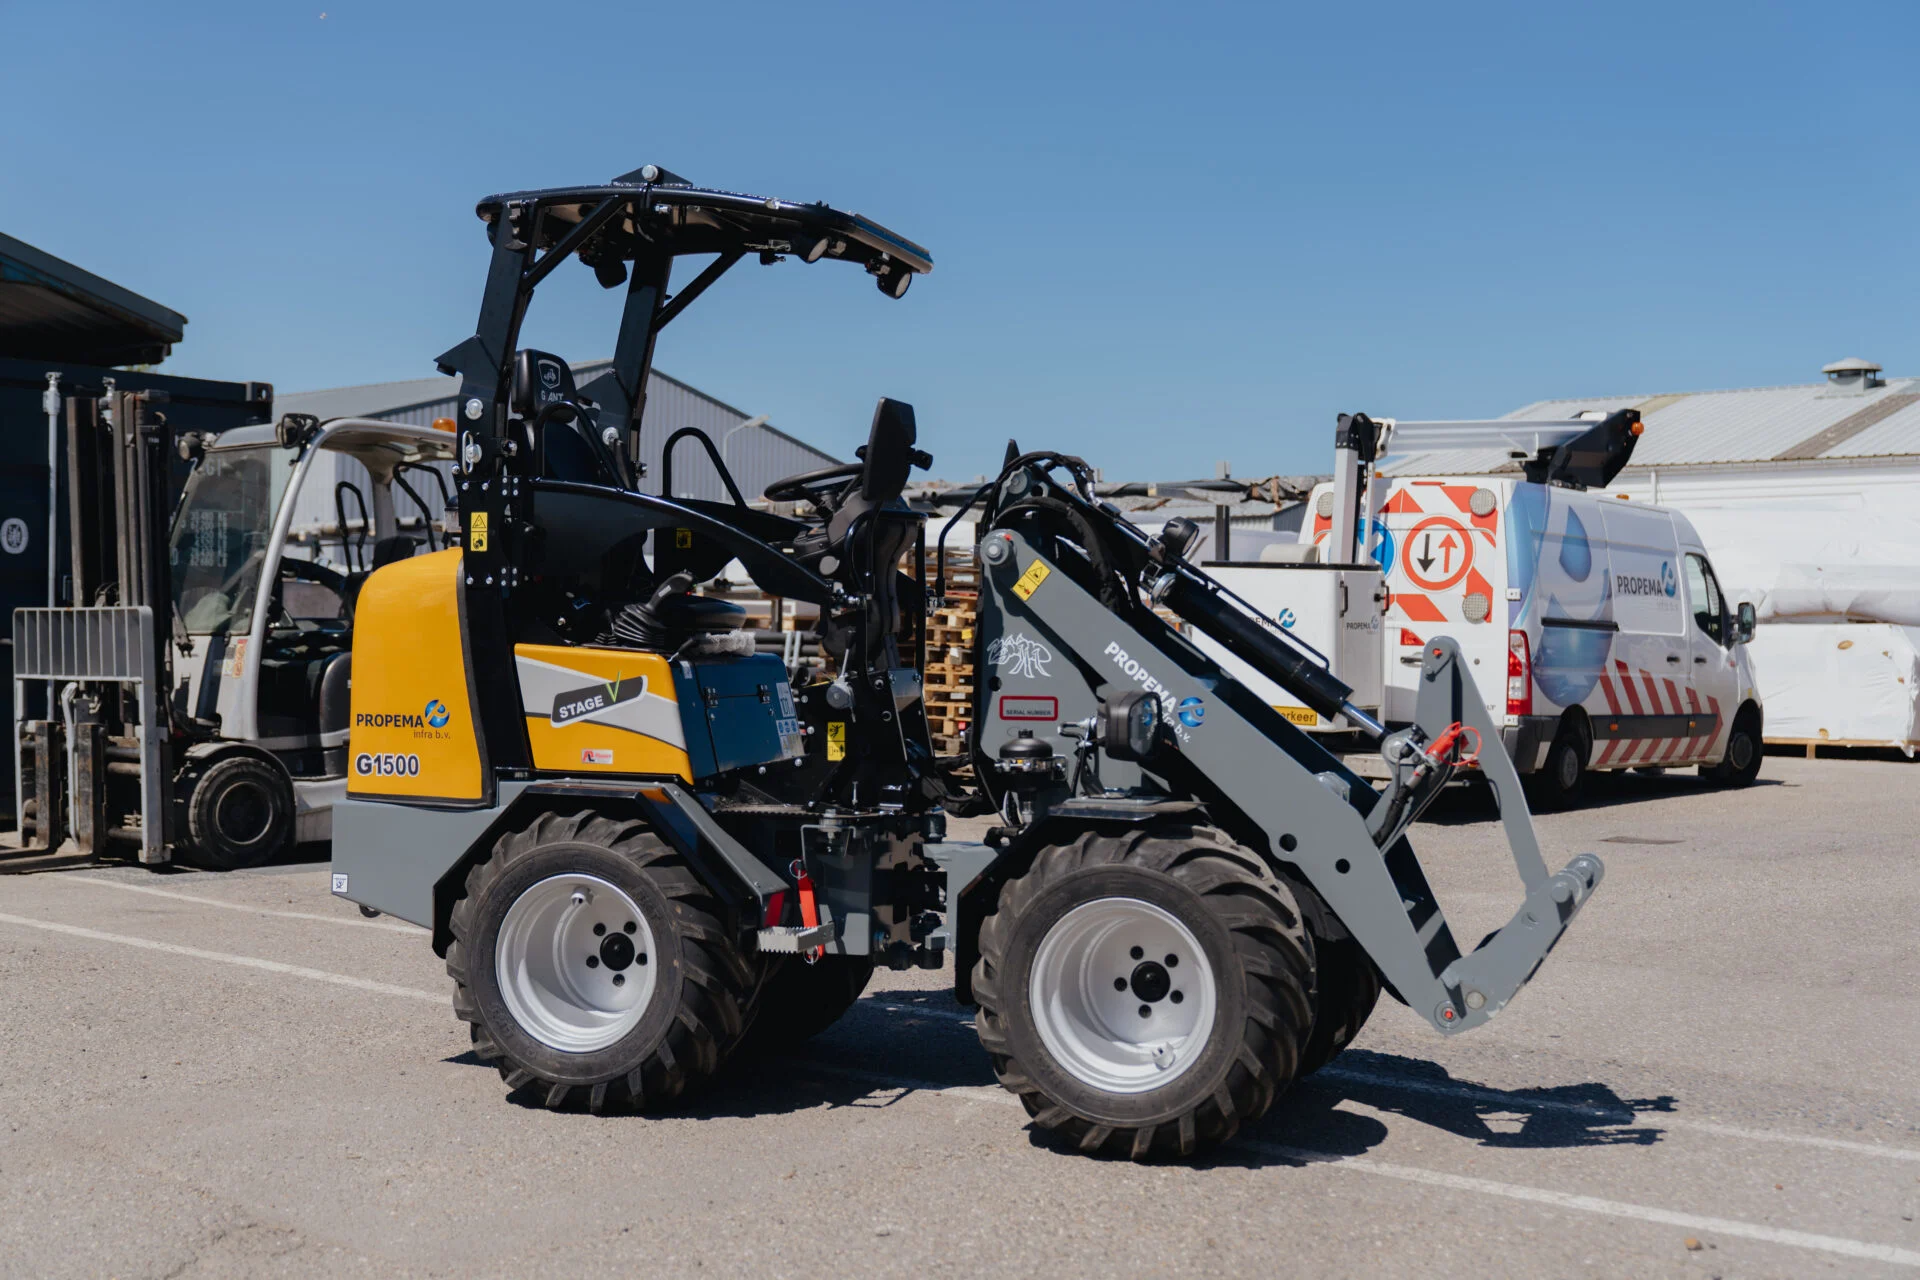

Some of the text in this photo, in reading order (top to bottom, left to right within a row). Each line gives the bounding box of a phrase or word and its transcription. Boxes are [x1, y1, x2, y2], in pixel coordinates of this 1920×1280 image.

[1616, 575, 1663, 597] PROPEMA
[1346, 621, 1371, 631] PROPEMA
[1104, 641, 1176, 713] PROPEMA
[559, 671, 621, 719] STAGE V
[356, 713, 424, 728] PROPEMA
[413, 730, 451, 739] infra b.v.
[356, 753, 420, 777] G1500
